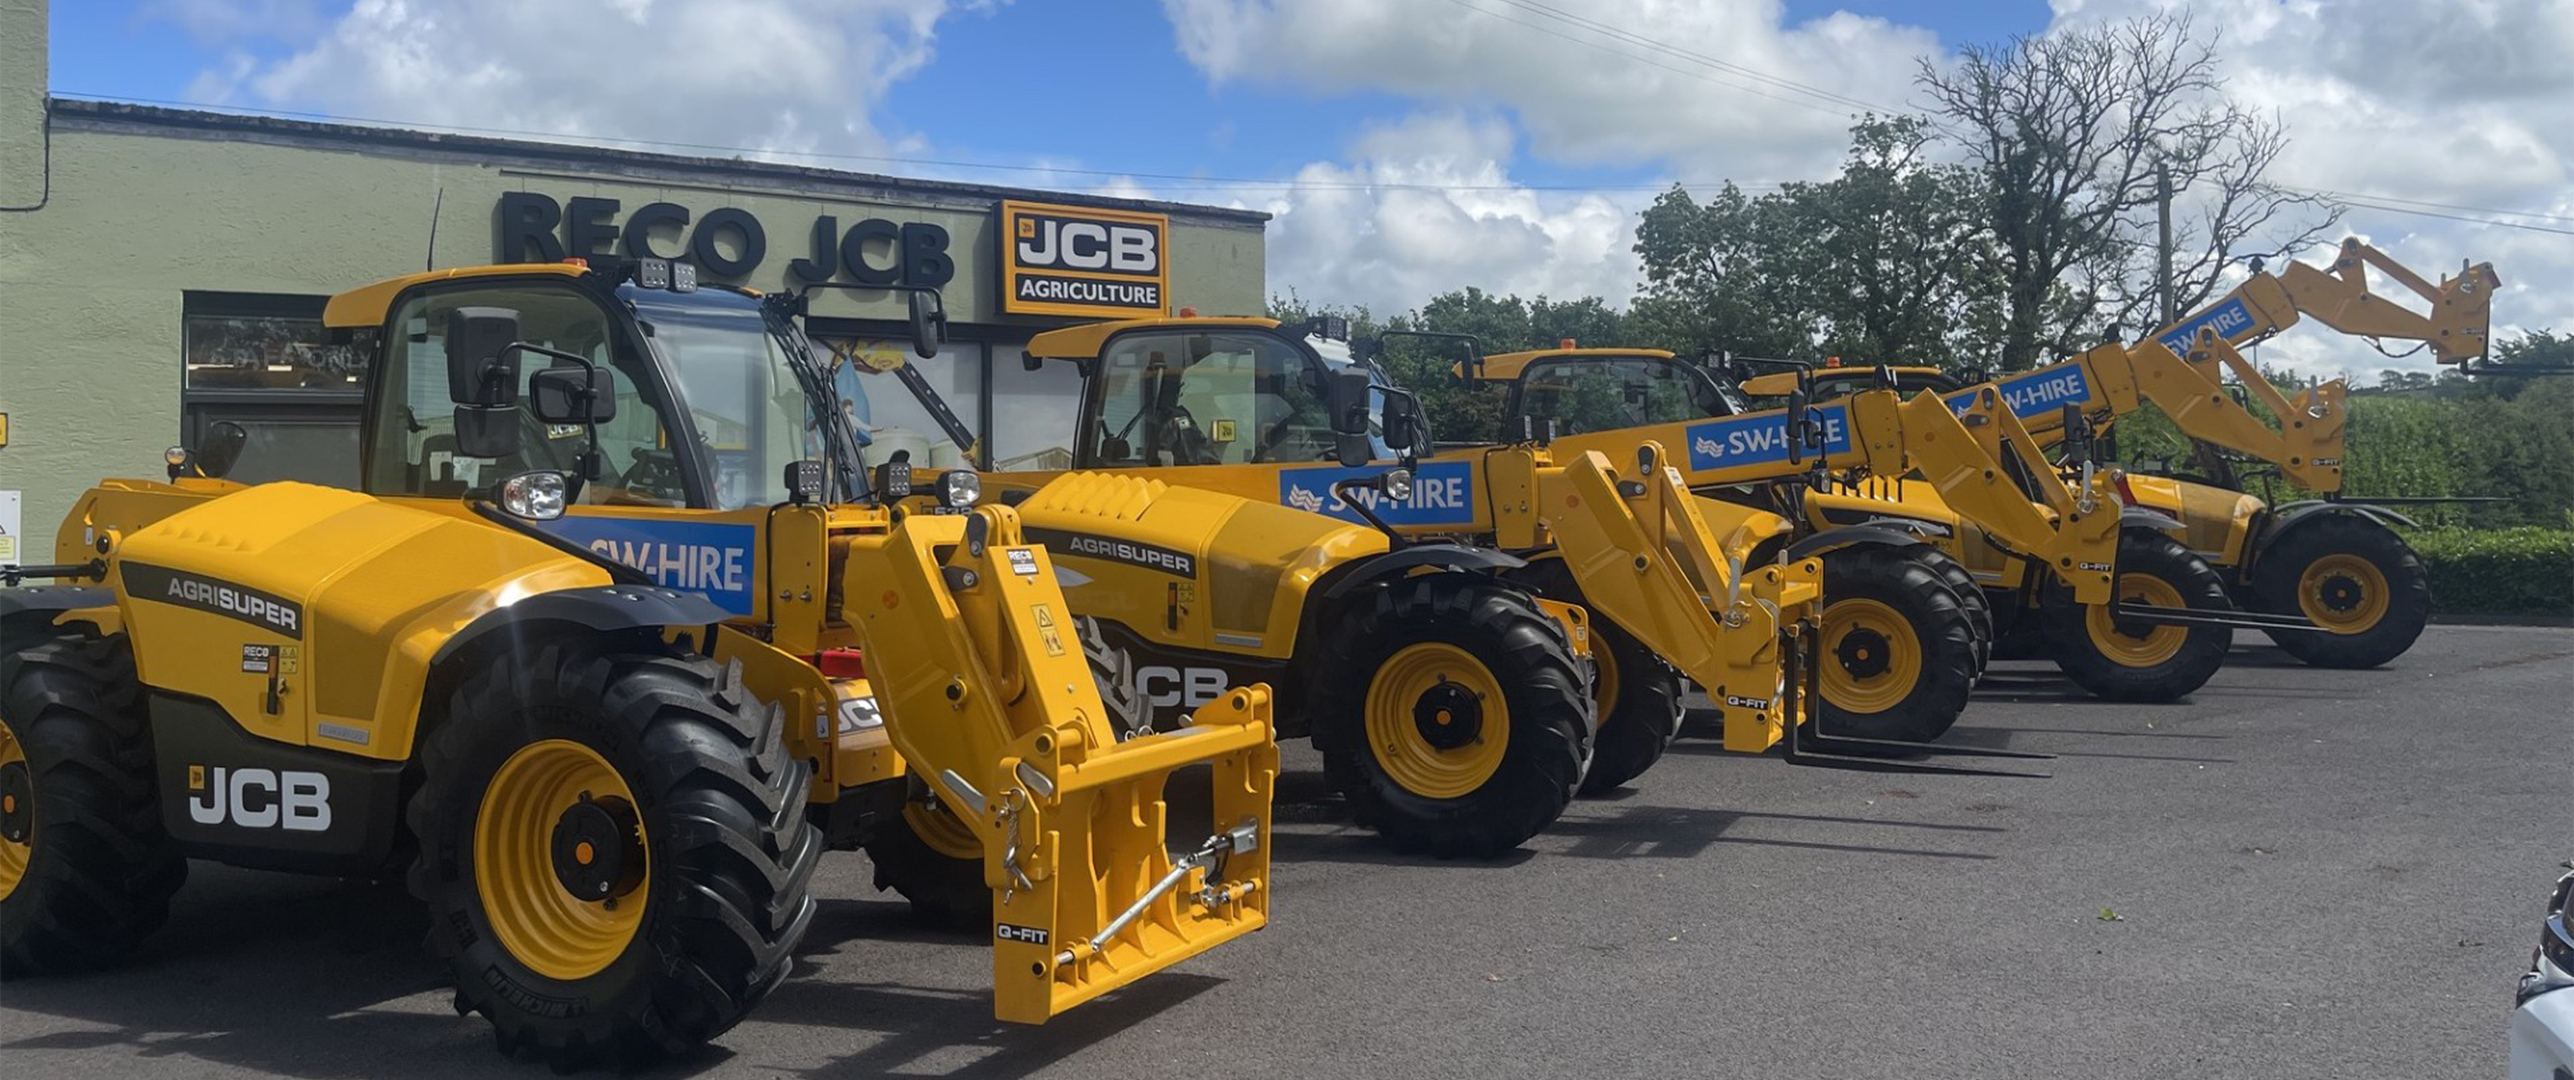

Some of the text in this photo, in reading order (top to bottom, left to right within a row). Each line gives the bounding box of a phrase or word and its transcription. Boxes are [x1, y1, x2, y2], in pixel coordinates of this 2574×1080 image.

[502, 191, 955, 286] RECO JCB
[1019, 220, 1157, 271] JCB
[1020, 279, 1157, 304] AGRICULTURE
[1070, 536, 1190, 573] AGRISUPER
[168, 578, 297, 630] AGRISUPER
[243, 646, 269, 657] RECO
[1728, 696, 1768, 709] Q-FIT
[189, 767, 332, 831] JCB
[998, 925, 1048, 943] Q-FIT
